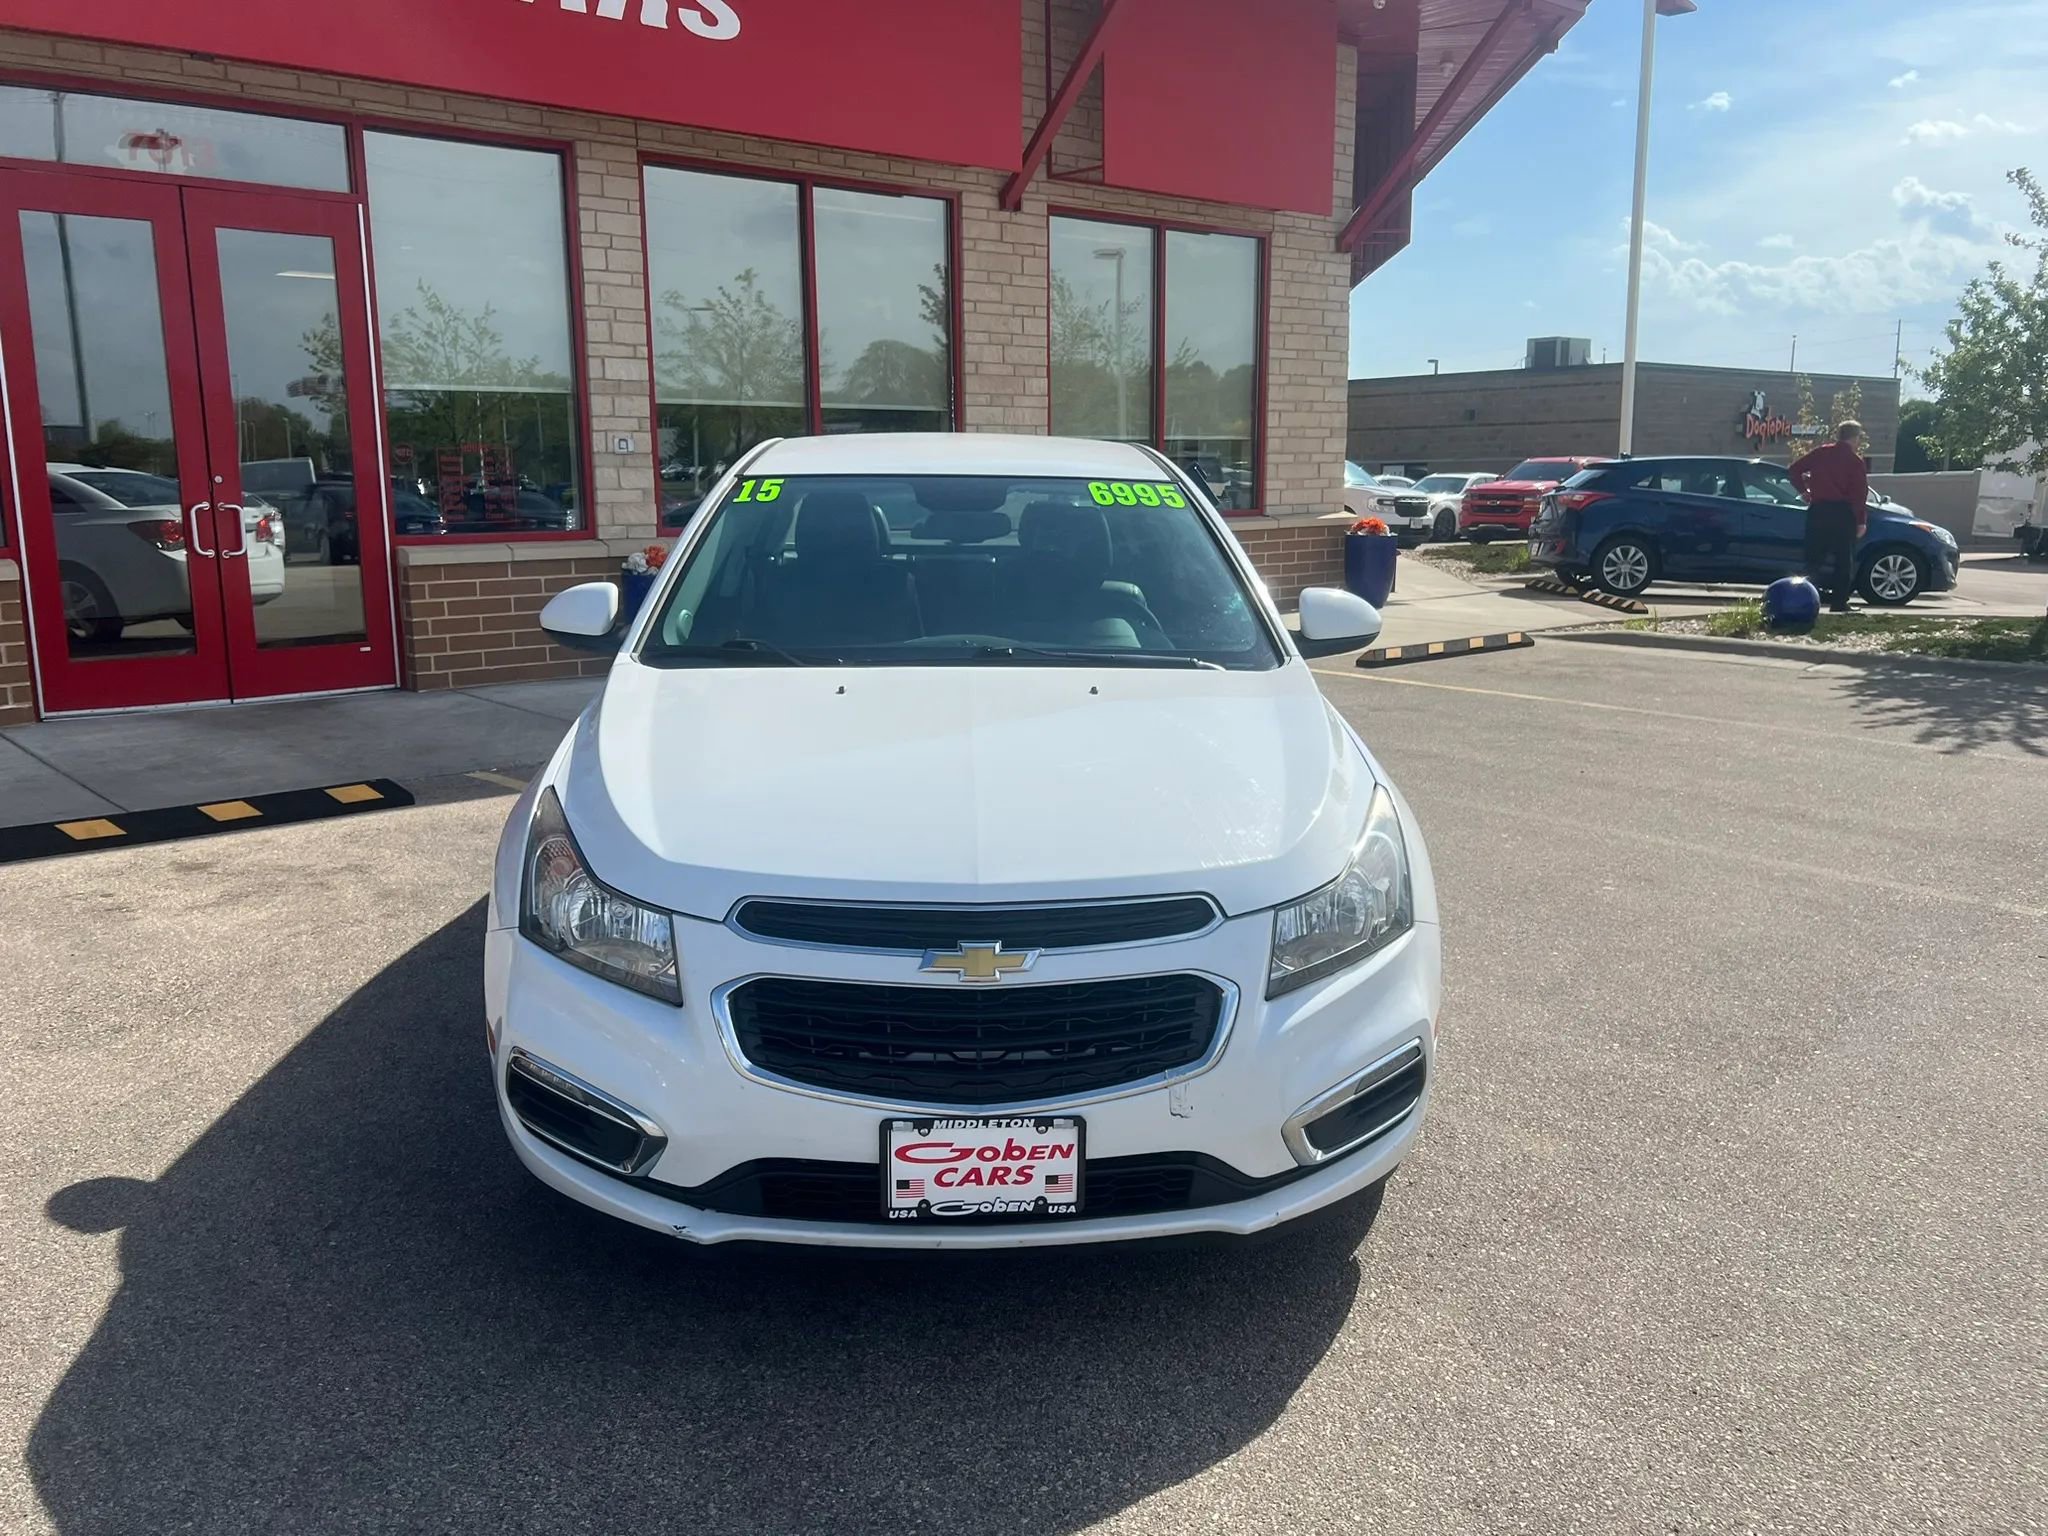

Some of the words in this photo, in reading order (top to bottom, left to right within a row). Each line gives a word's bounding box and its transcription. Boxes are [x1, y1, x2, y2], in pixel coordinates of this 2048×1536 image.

[1746, 405, 1792, 449] Dogtopia
[733, 479, 784, 502] 15
[1088, 482, 1185, 508] 6995
[932, 1118, 1035, 1129] MIDDLETON
[933, 1165, 1036, 1188] CARS
[888, 1209, 919, 1219] USA
[1048, 1204, 1077, 1214] USA
